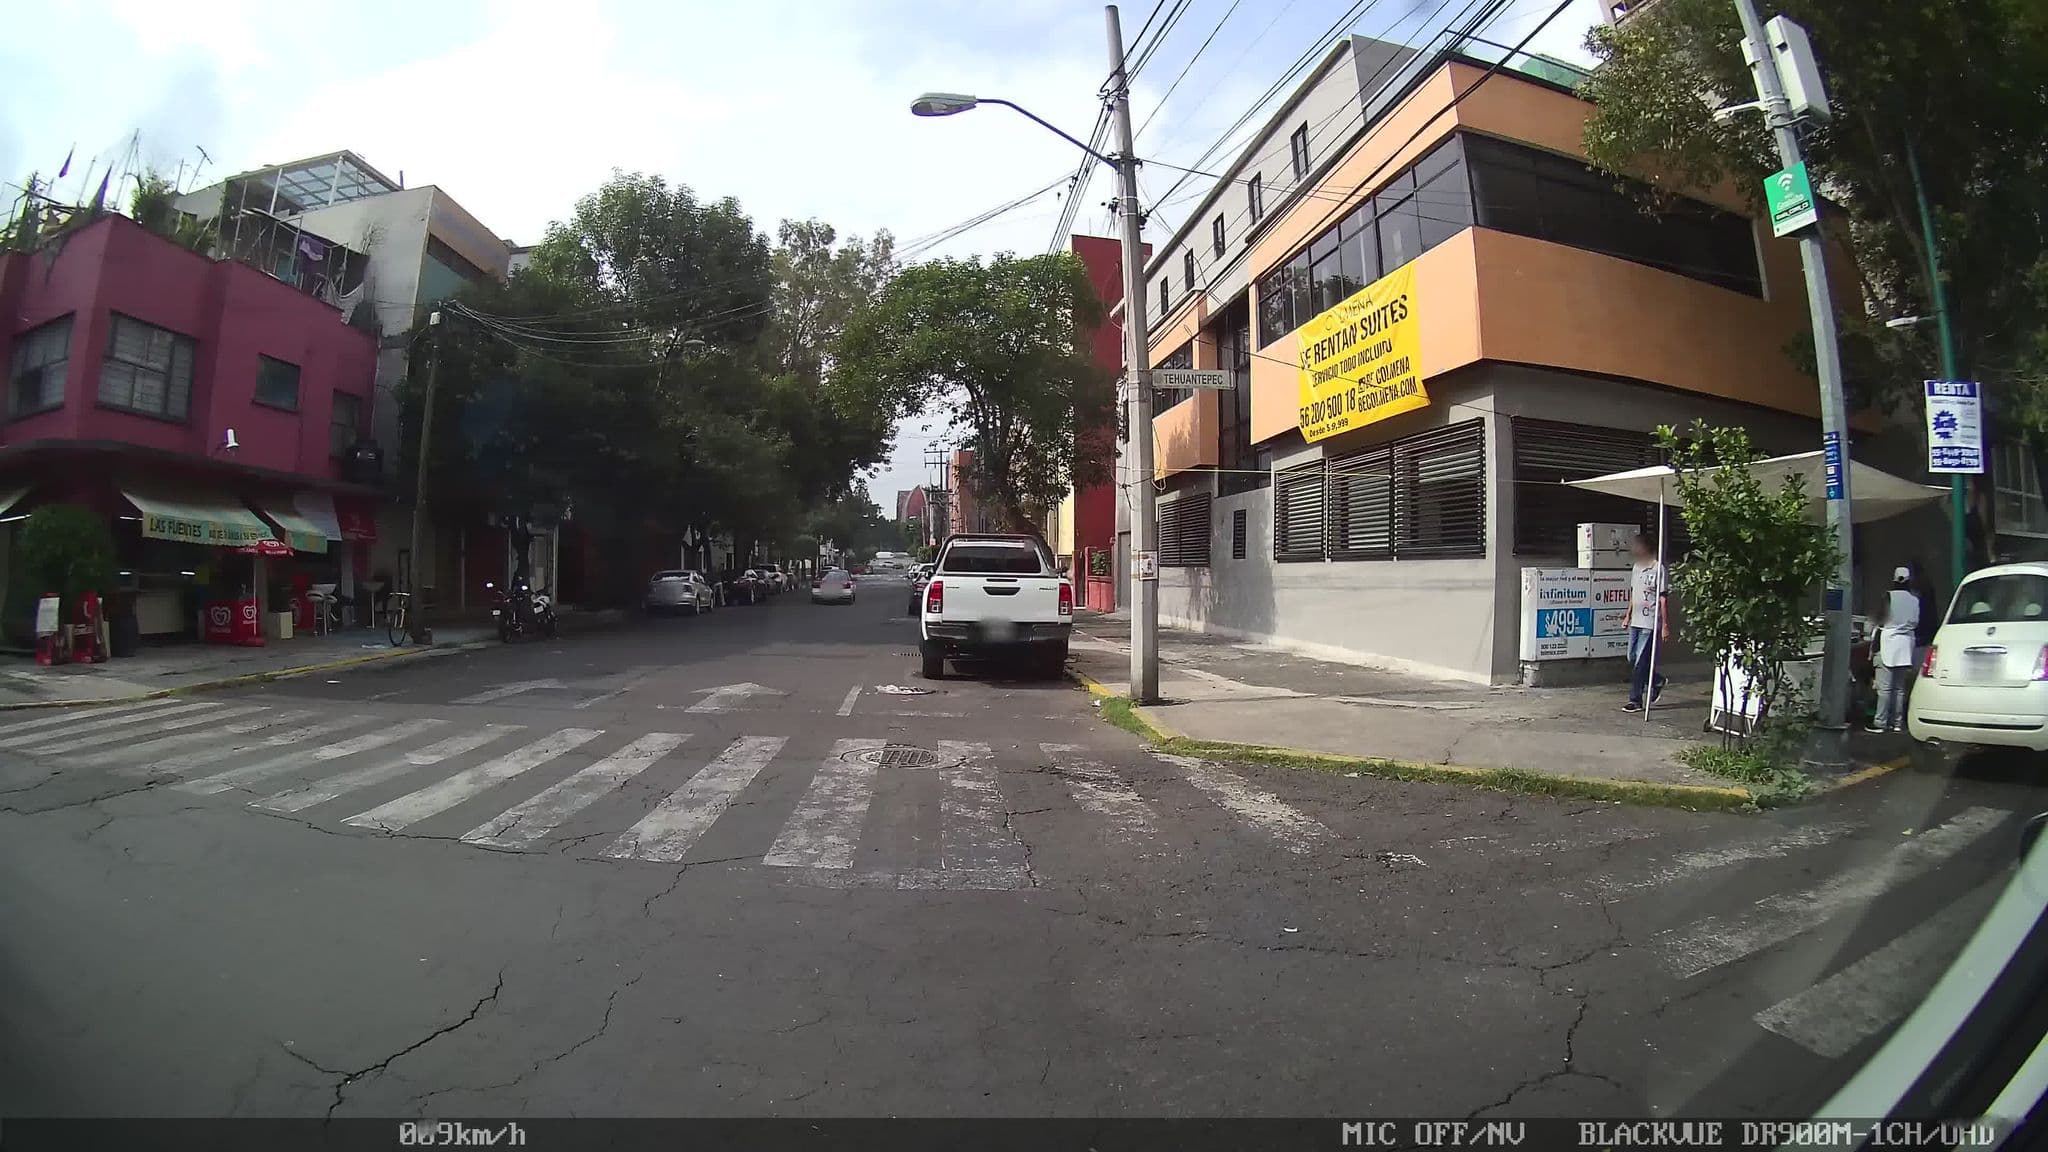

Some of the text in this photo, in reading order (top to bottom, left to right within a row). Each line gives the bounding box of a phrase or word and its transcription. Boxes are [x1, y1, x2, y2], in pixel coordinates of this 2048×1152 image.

[1313, 322, 1357, 365] RENTAN
[1360, 294, 1408, 341] SUITES
[1340, 355, 1357, 375] TODO
[1376, 356, 1411, 385] COLMENA
[1163, 373, 1224, 385] TEHUANTEPEC
[1933, 383, 1969, 397] RENTA
[1299, 407, 1310, 429] 56
[1326, 393, 1343, 419] 500
[1345, 387, 1356, 412] 18
[149, 517, 166, 534] LAS
[168, 519, 202, 538] FUENTES
[1540, 588, 1586, 599] infinitum
[1603, 588, 1631, 604] NETFLI
